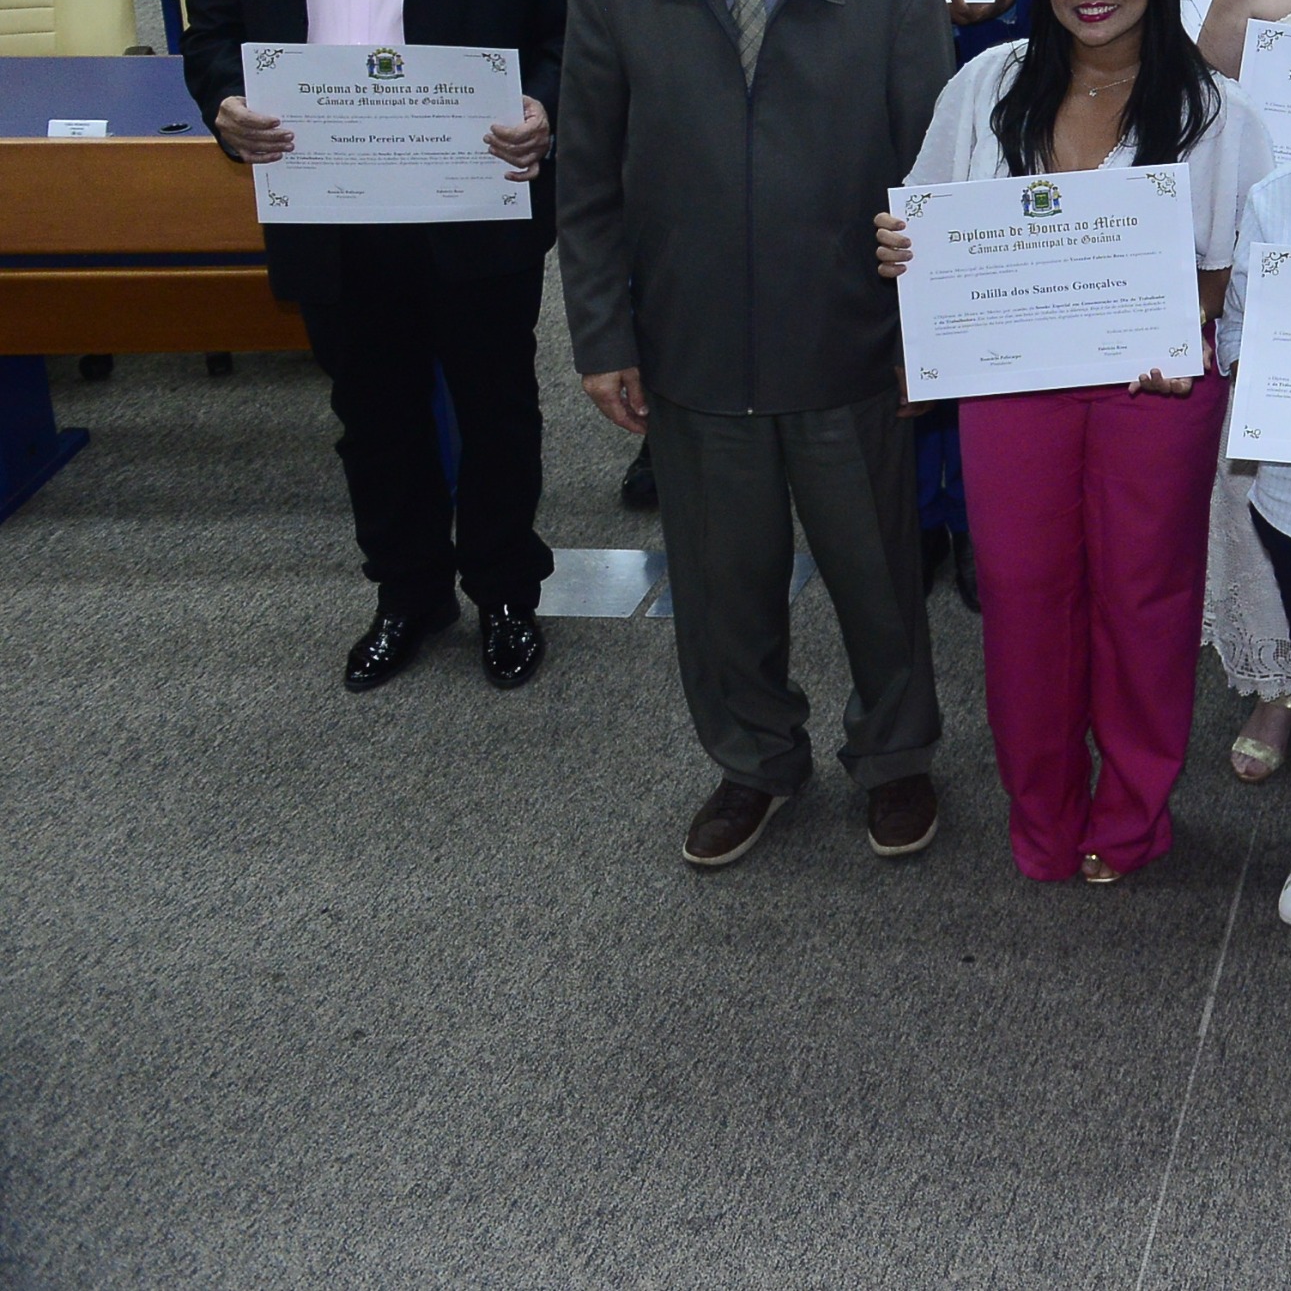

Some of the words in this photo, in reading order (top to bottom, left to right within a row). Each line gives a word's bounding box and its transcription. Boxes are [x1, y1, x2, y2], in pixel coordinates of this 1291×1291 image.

[297, 83, 351, 95] Diploma
[354, 84, 368, 94] de
[371, 83, 412, 95] Honra
[415, 85, 430, 94] ao
[433, 82, 475, 95] Mérito
[330, 135, 366, 143] Sandro
[368, 134, 405, 143] Pereira
[408, 134, 452, 143] Valverde
[947, 228, 1005, 243] Diploma
[1008, 225, 1023, 237] de
[1026, 222, 1070, 237] Honra
[1074, 221, 1089, 231] ao
[1092, 214, 1138, 231] Mérito
[968, 243, 1010, 255] Câmara
[1012, 237, 1064, 252] Municipal
[1066, 237, 1078, 246] de
[1080, 234, 1121, 245] Goiânia
[971, 288, 1008, 301] Dalilla
[1010, 286, 1030, 297] dos
[1032, 284, 1070, 295] Santos
[1072, 278, 1128, 291] Gonçalves
